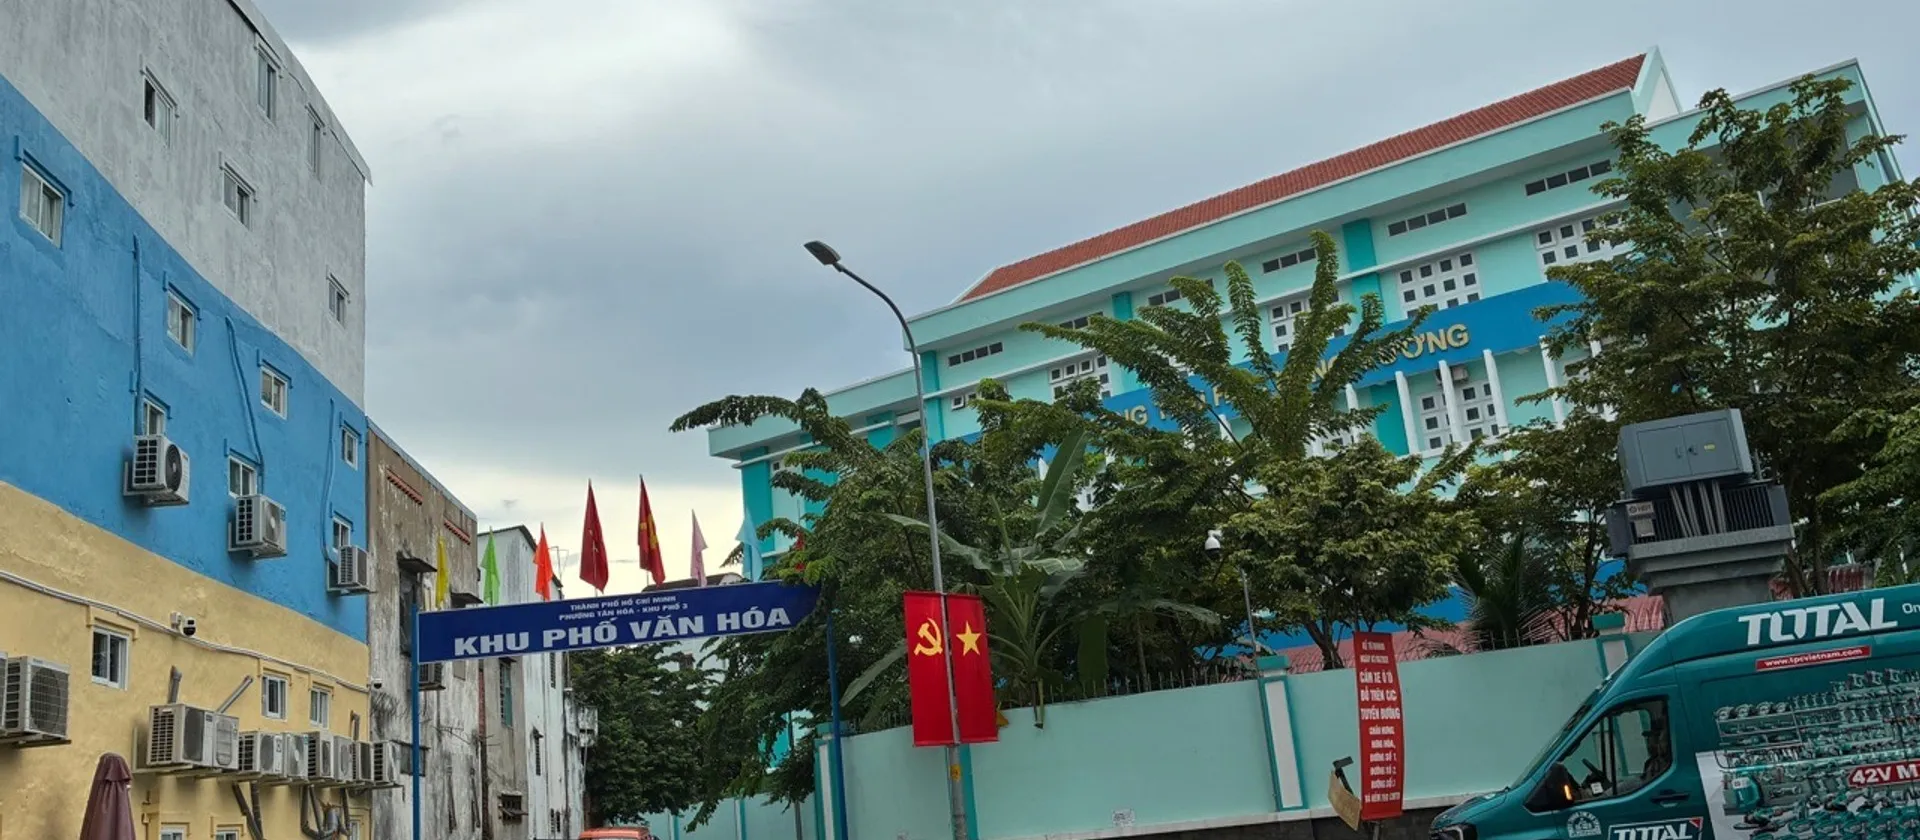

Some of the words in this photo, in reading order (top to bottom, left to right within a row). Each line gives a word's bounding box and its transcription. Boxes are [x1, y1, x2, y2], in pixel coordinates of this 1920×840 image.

[559, 611, 595, 621] PHƯỜNG
[597, 609, 615, 617] TÂN
[642, 604, 660, 613] KHU
[663, 602, 680, 611] PHỐ
[570, 602, 599, 611] THÀNH
[602, 599, 619, 608] PHỐ
[621, 598, 633, 606] HỒ
[635, 596, 650, 605] CHÍ
[653, 595, 676, 603] MINH
[1738, 598, 1898, 646] TOTAL
[454, 631, 530, 657] KHU
[543, 617, 618, 647] PHỐ
[629, 614, 703, 639] VĂN
[717, 607, 791, 631] HÓA
[1764, 649, 1862, 667] www.tpcvietnam.com
[1852, 766, 1891, 784] 42V
[1896, 763, 1920, 779] M
[1613, 823, 1693, 840] TOTAL
